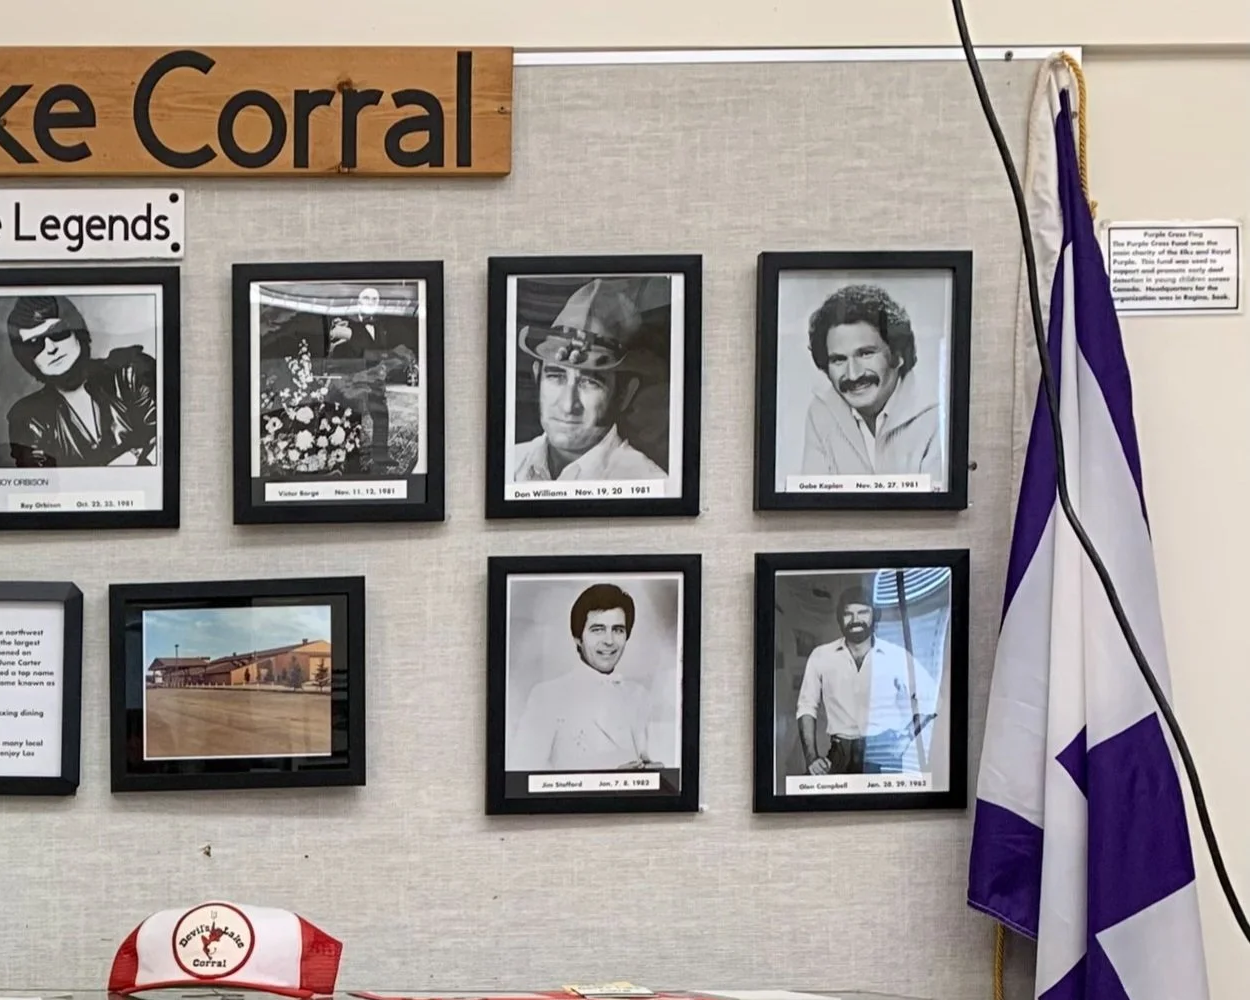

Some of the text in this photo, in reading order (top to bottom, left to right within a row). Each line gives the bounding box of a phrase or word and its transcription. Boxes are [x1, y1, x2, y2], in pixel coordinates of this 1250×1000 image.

[133, 49, 471, 170] Corral
[13, 202, 171, 252] Legends
[514, 486, 650, 498] Don Williams Nov. 19, 20 1981
[17, 657, 42, 666] Carter
[179, 924, 245, 949] Devil's Lake
[193, 958, 226, 968] Corral
